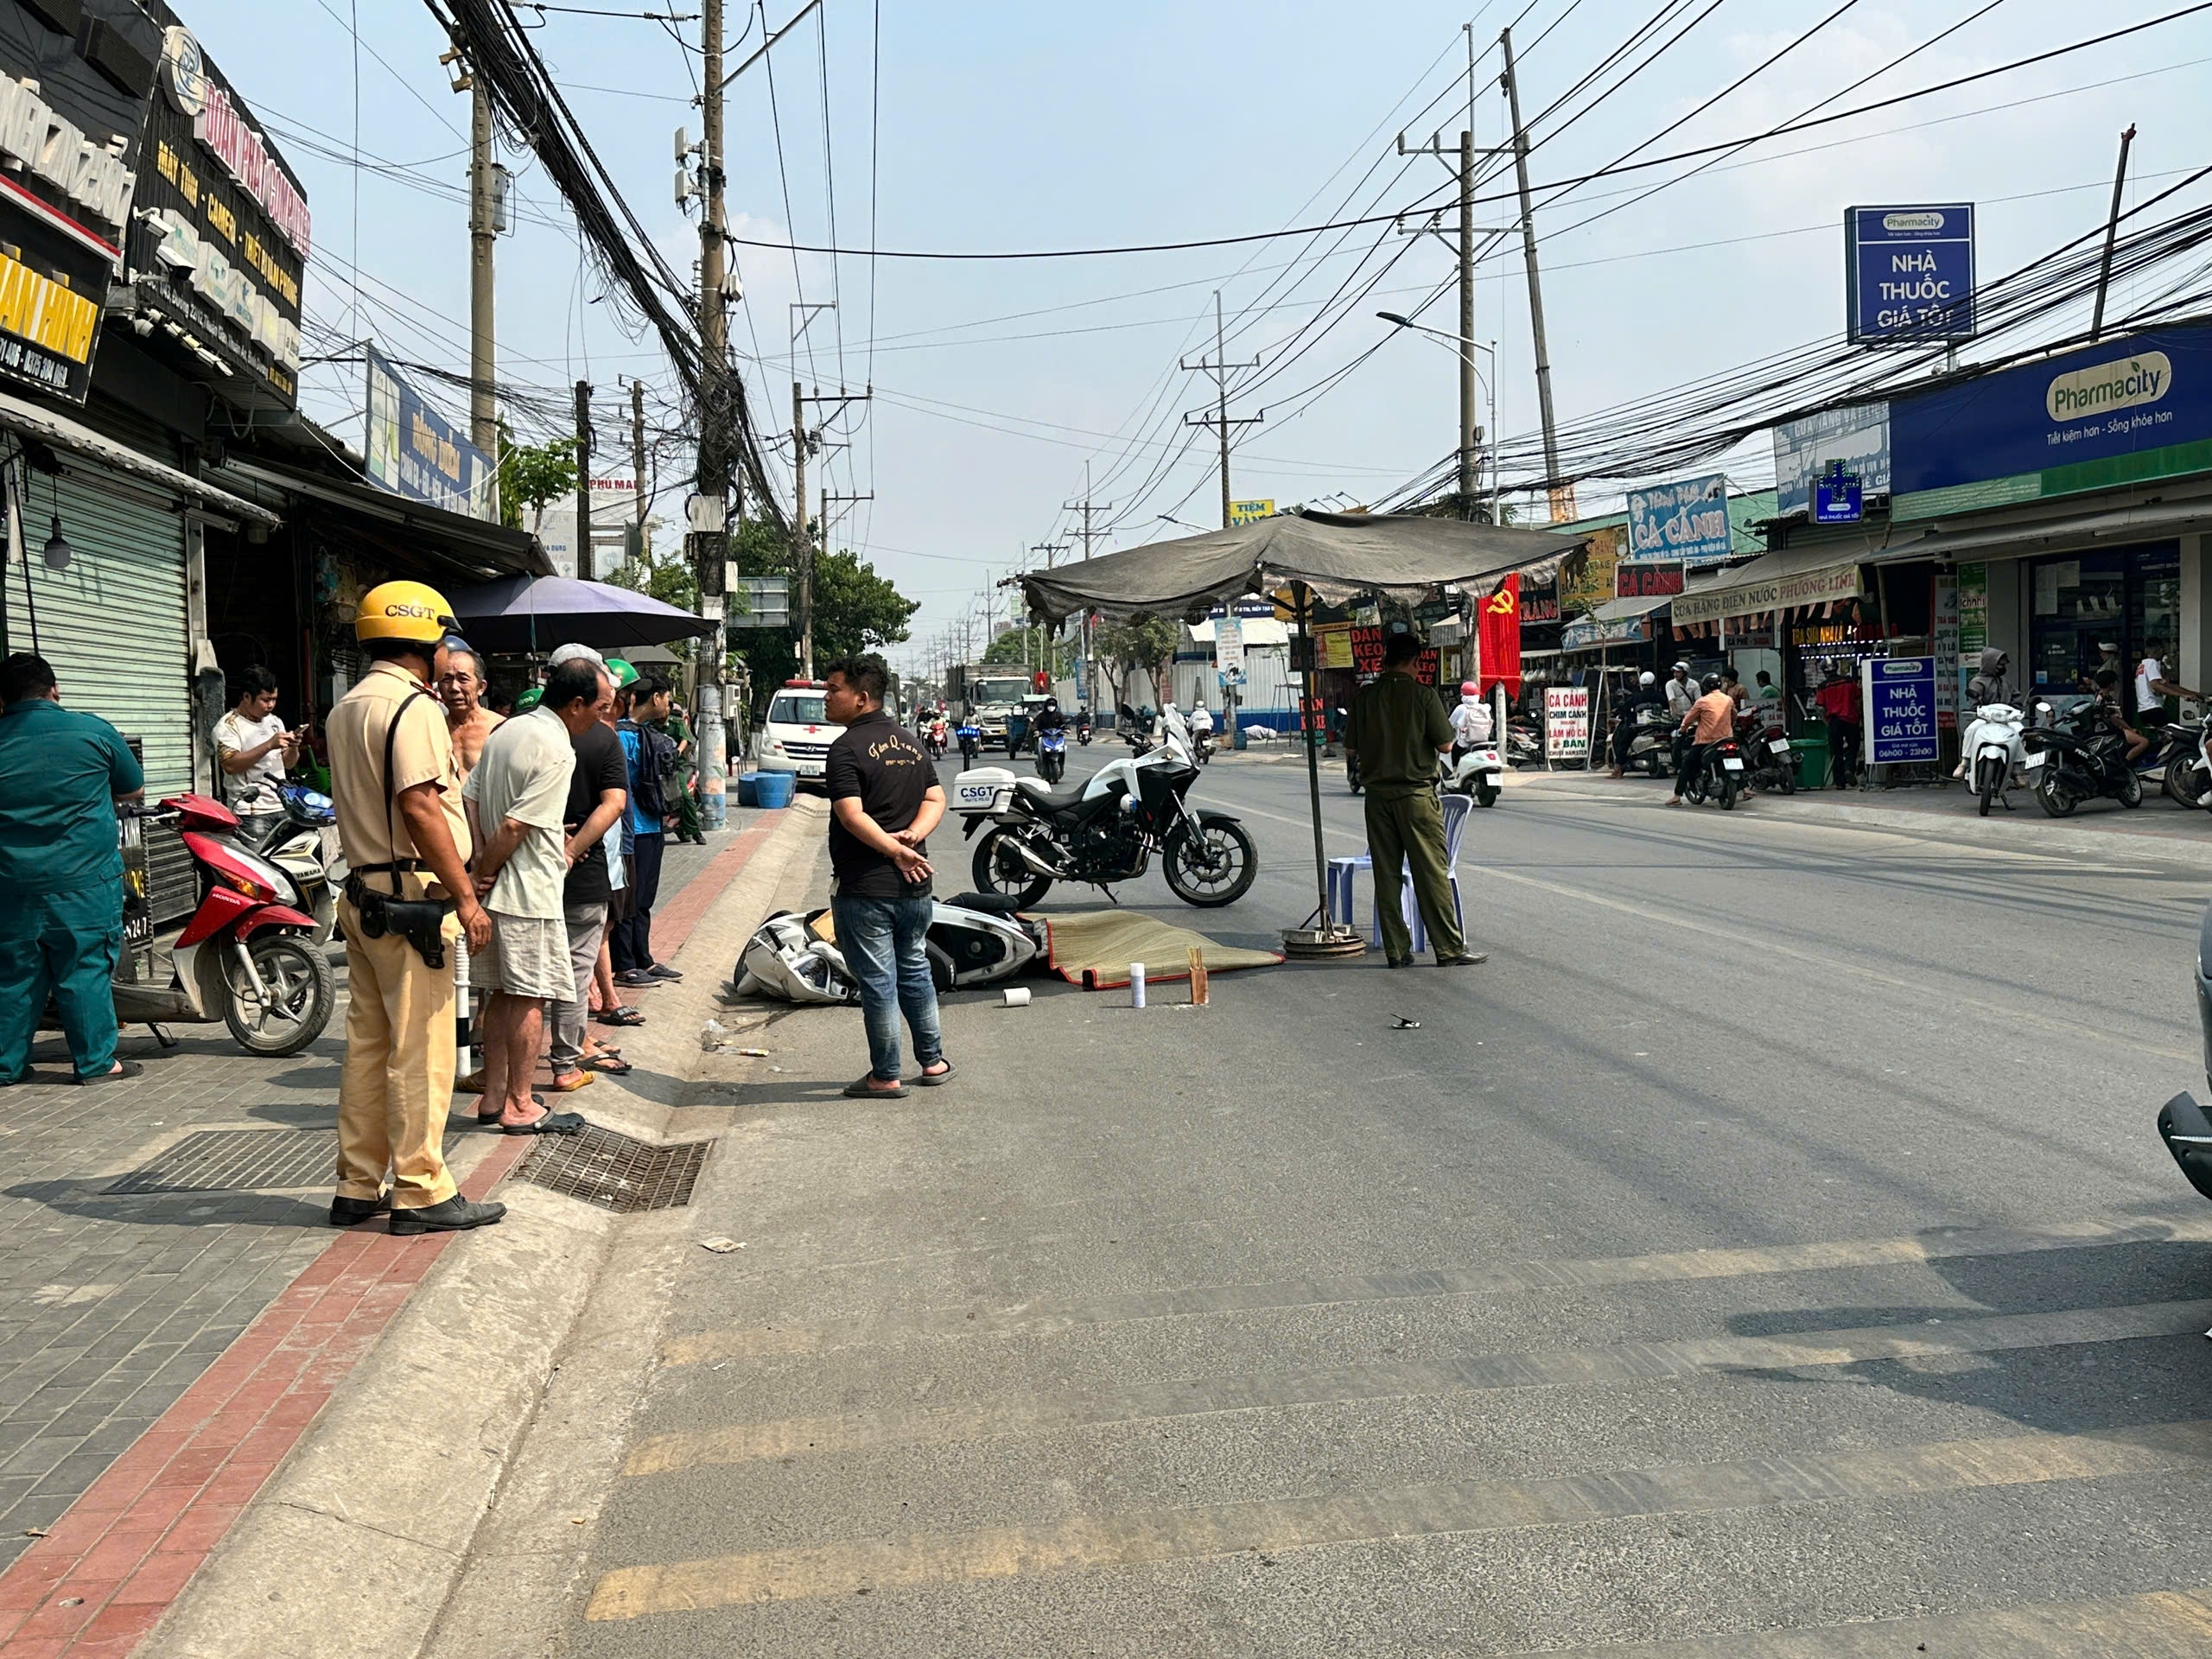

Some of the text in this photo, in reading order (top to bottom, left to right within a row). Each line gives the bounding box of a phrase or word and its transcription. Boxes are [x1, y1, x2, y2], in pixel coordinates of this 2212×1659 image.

[1886, 215, 1940, 227] Pharmacity
[1891, 250, 1936, 272] NHÀ
[1878, 273, 1950, 301] THUỐC
[1877, 305, 1912, 328] GIÁ
[2055, 361, 2161, 413] Pharmacity
[2047, 430, 2061, 445] Tiết
[2063, 429, 2082, 442] kiệm
[2083, 426, 2100, 438] hơn
[2107, 417, 2129, 433] Sống
[2131, 413, 2153, 429] khỏe
[2155, 410, 2172, 423] hơn
[1236, 501, 1266, 513] TIỆM
[1665, 506, 1726, 545] CẢNH
[1618, 568, 1638, 596] CÁ
[1642, 563, 1682, 595] CẢNH
[1694, 598, 1720, 614] HÀNG
[1722, 592, 1745, 610] ĐIỆN
[1748, 584, 1777, 604] NƯỚC
[1780, 577, 1826, 599] PHƯƠNG
[1827, 573, 1855, 589] LINH
[385, 604, 435, 620] CSGT
[1354, 643, 1383, 657] KEO
[1358, 658, 1382, 672] XE
[1885, 663, 1920, 672] Pharmacity
[1563, 690, 1587, 708] CẢNH
[1890, 684, 1917, 699] NHÀ
[1549, 710, 1567, 719] CHIM
[1882, 700, 1926, 718] THUỐC
[1881, 718, 1929, 736] GIÁ TỐT
[1910, 747, 1932, 756] 23h00
[296, 868, 321, 879] YAMAHA
[212, 892, 241, 906] HONDA
